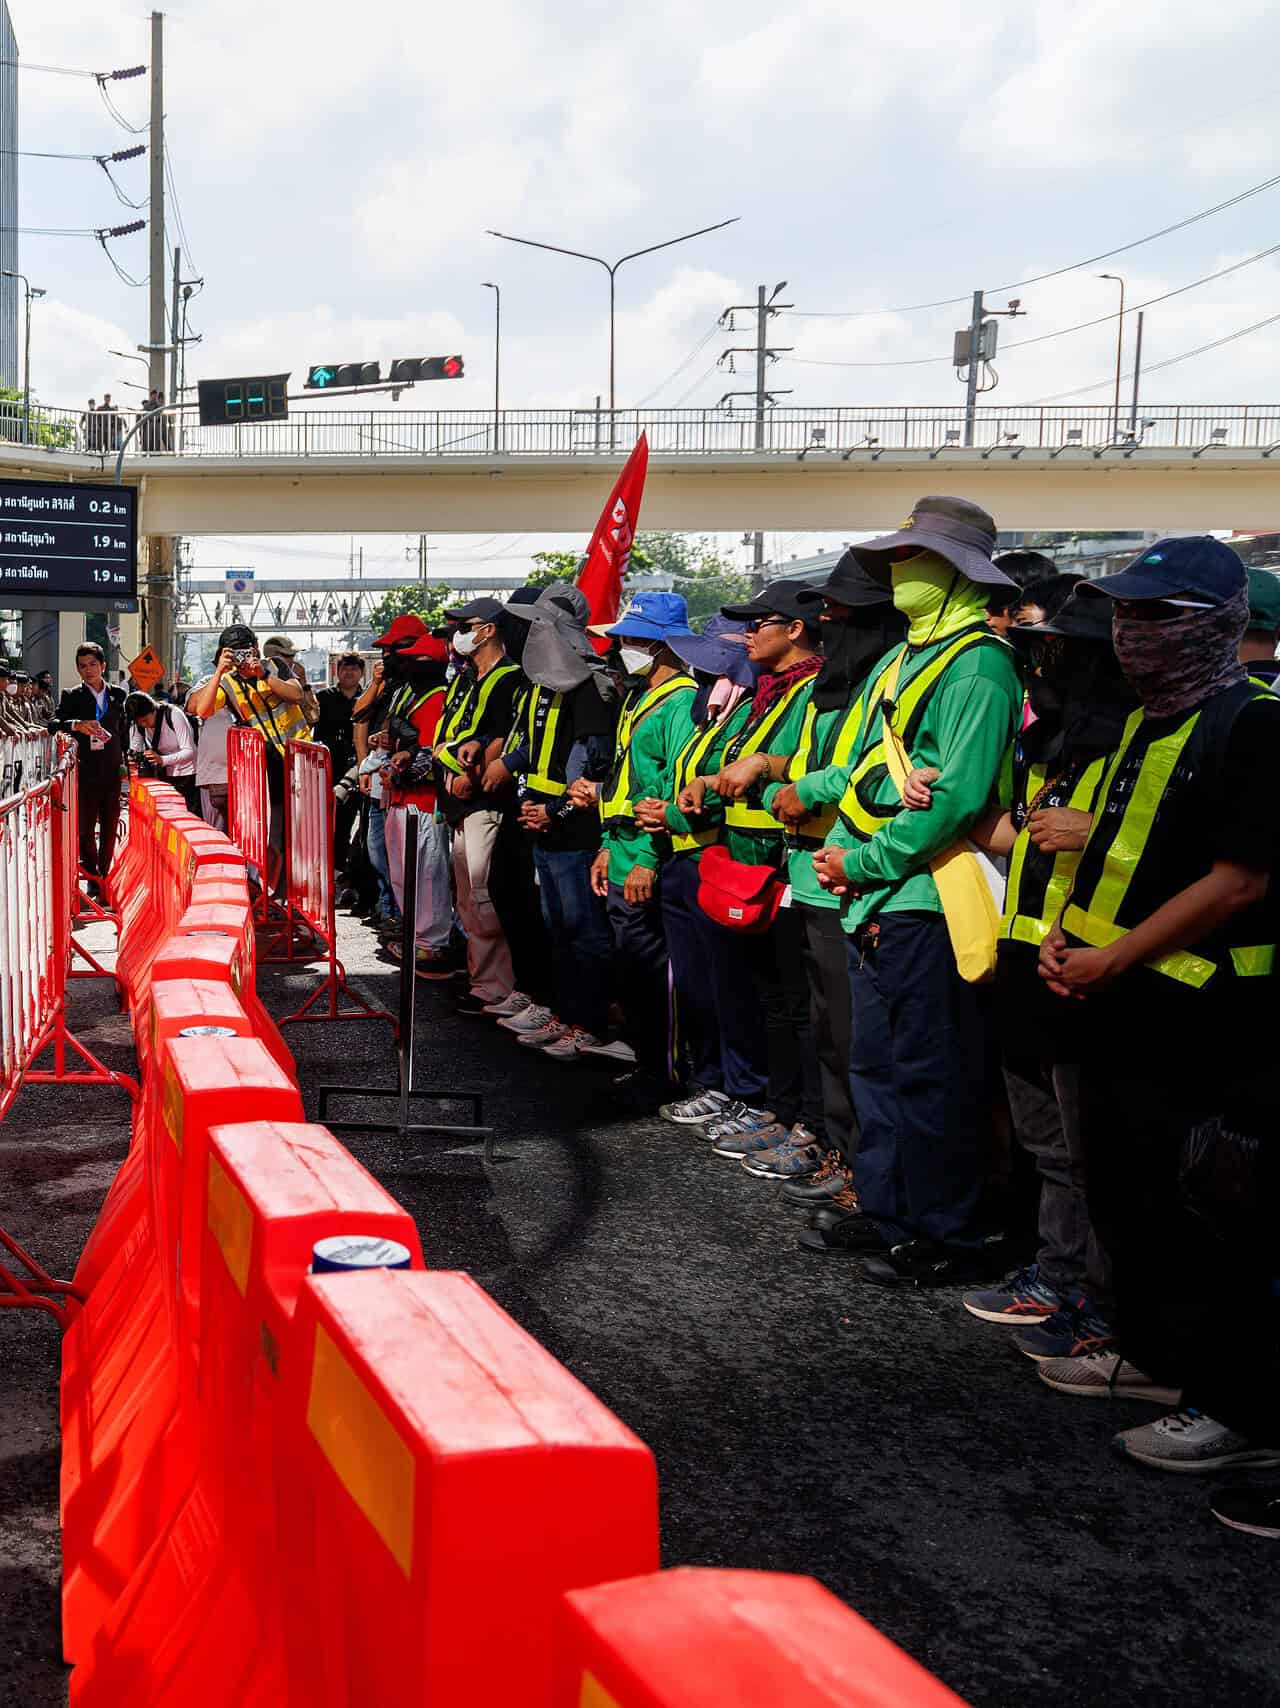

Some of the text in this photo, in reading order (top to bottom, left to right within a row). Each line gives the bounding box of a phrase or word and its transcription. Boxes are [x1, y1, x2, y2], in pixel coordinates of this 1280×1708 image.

[89, 501, 126, 514] 0.2 km
[4, 531, 55, 547] สถานีสุขุมวิท
[93, 536, 126, 549] 1.9 km
[4, 565, 48, 579] สถานีอโศก
[93, 570, 126, 583] 1.9 km
